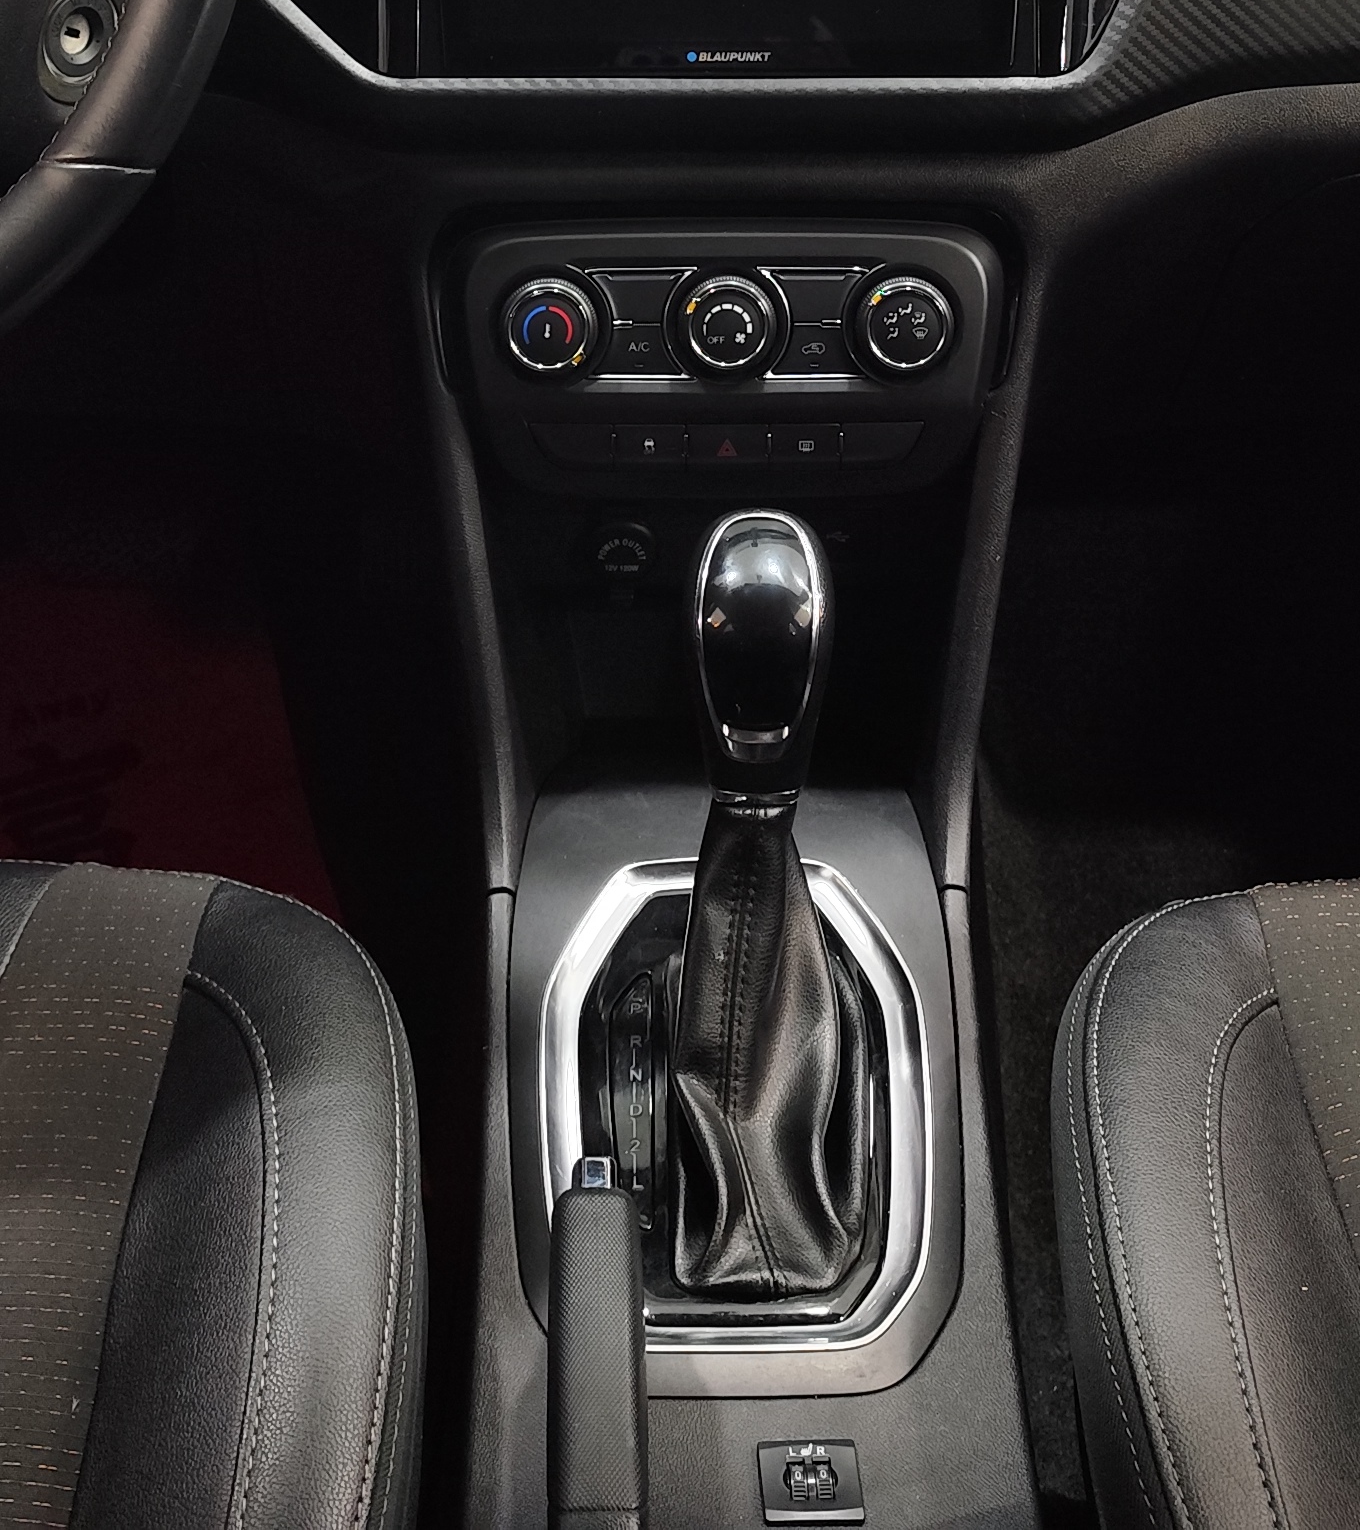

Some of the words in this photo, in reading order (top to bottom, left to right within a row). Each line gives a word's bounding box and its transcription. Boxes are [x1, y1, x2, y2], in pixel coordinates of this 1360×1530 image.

[698, 51, 772, 62] BLAUPUNKT
[706, 335, 726, 345] OFF
[627, 341, 651, 352] A/C
[597, 538, 621, 561] POWER
[621, 538, 647, 560] OUTLET
[788, 1446, 797, 1456] L
[816, 1445, 826, 1456] R
